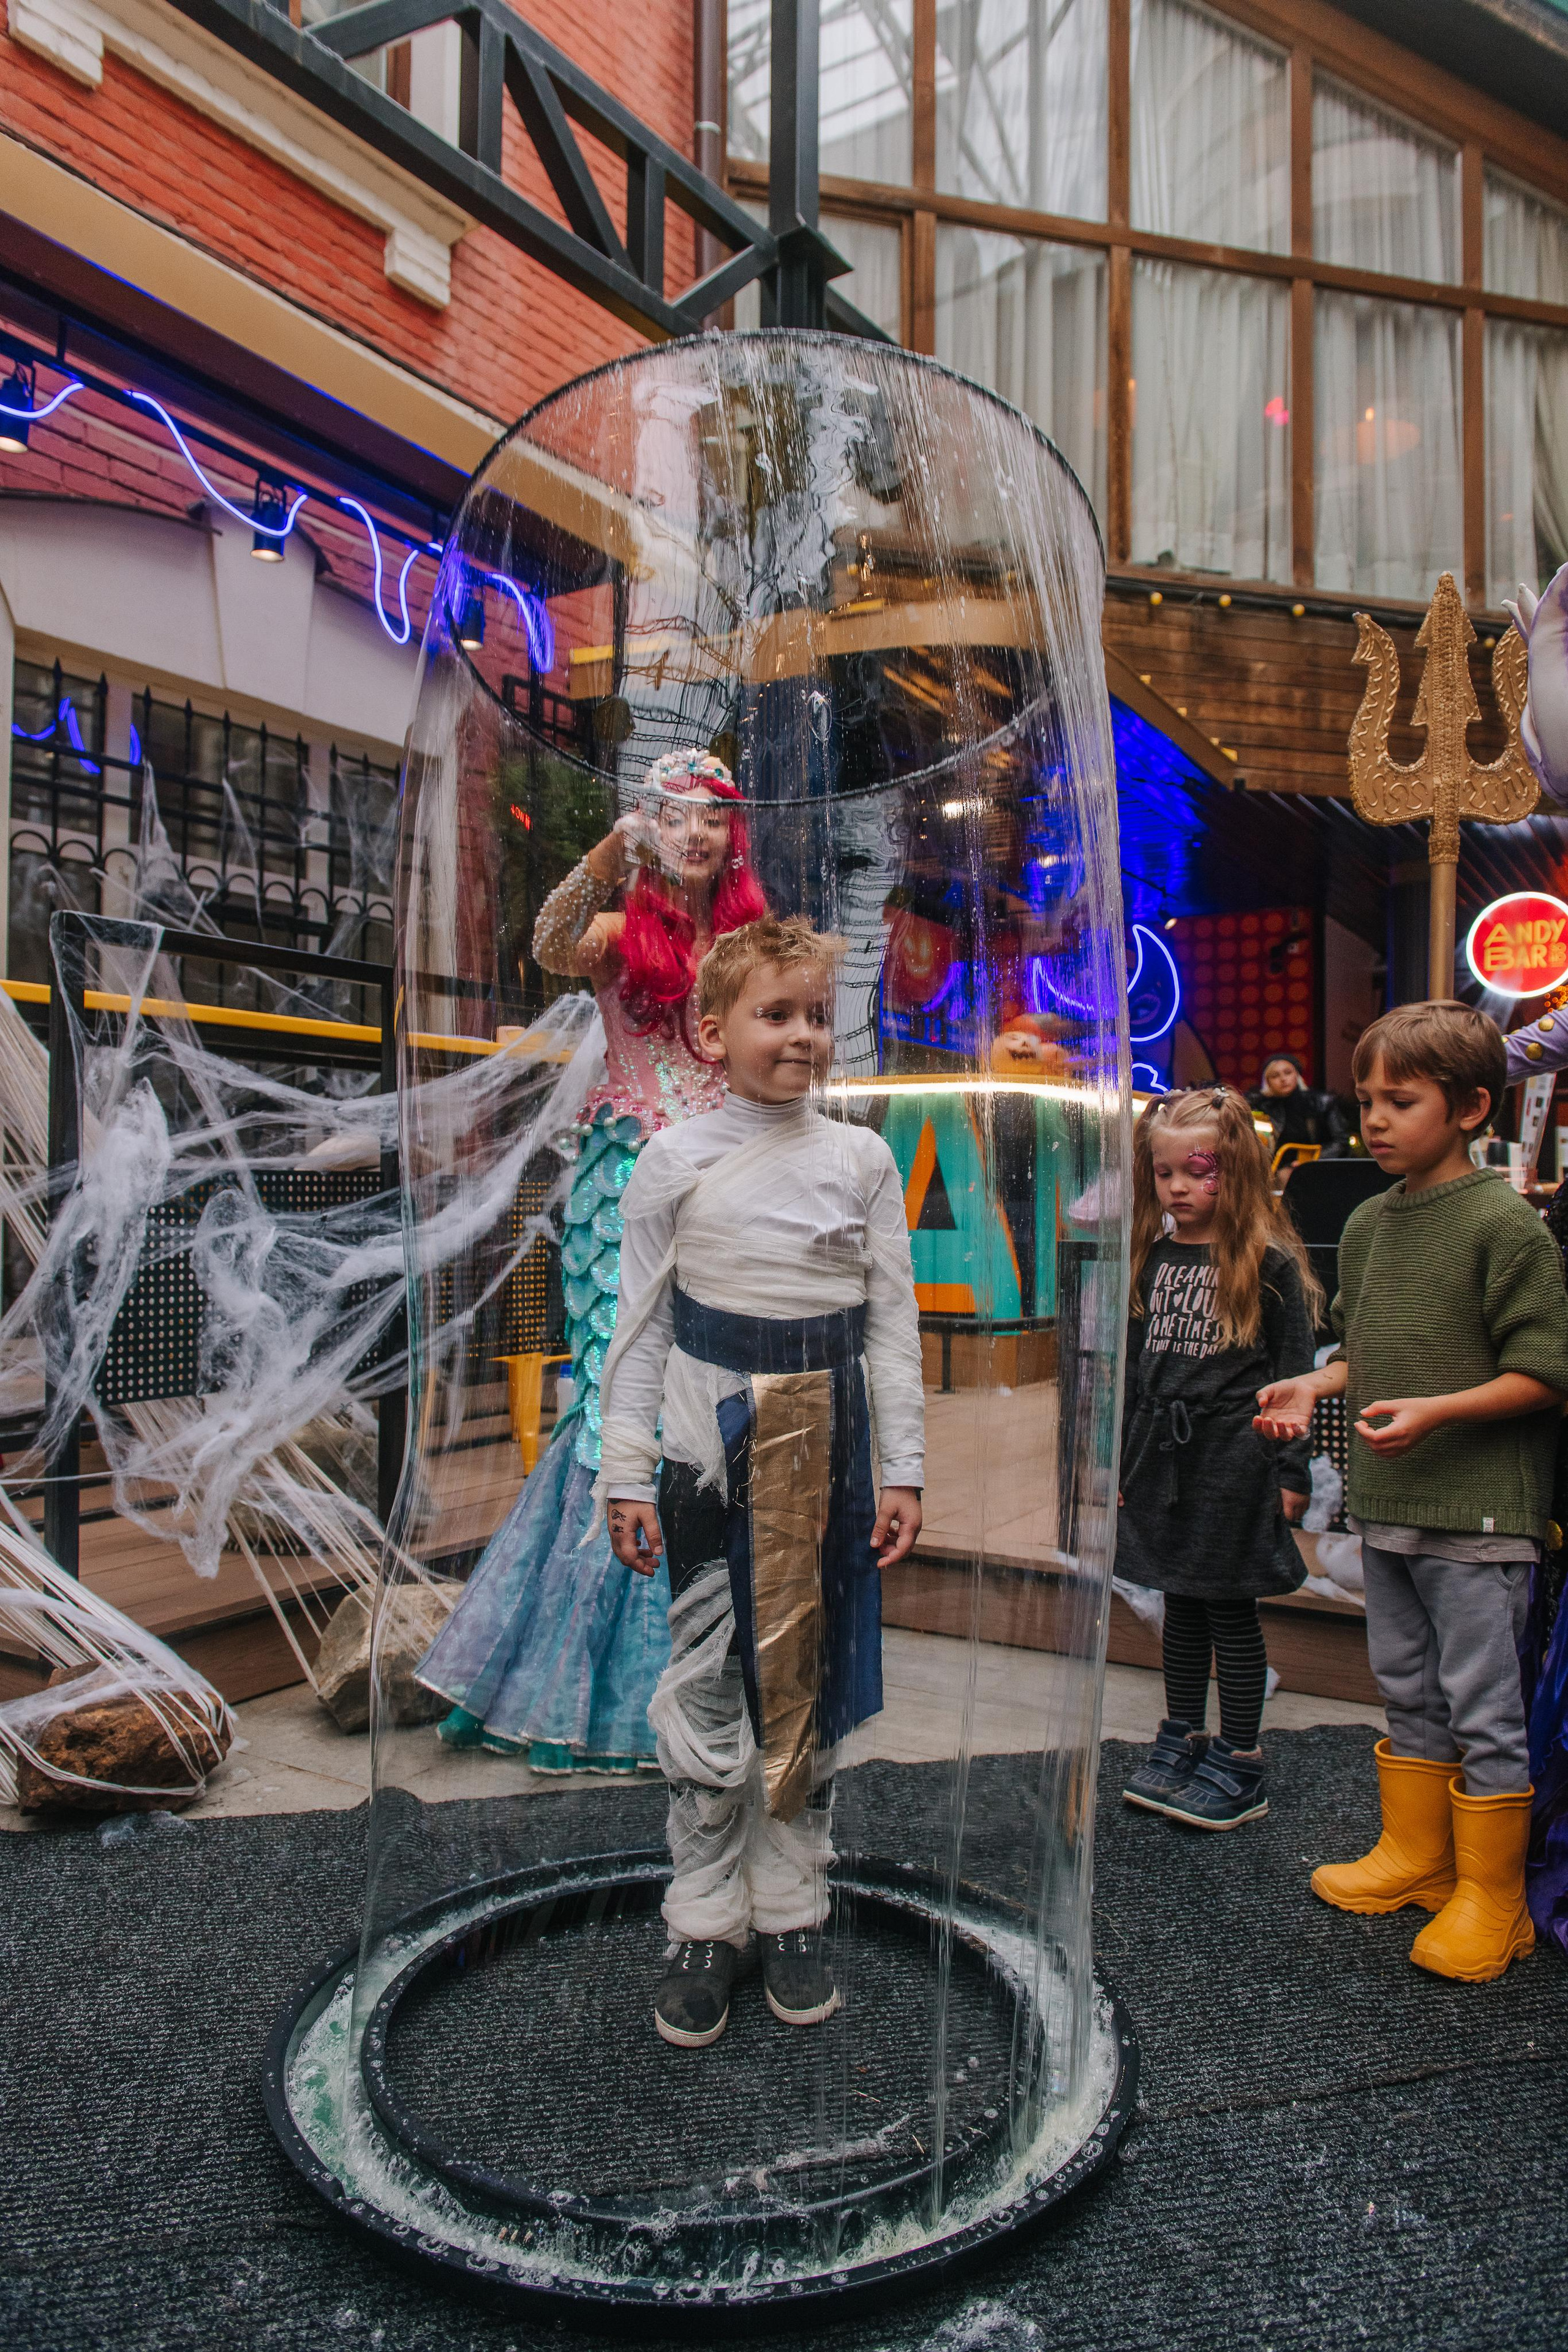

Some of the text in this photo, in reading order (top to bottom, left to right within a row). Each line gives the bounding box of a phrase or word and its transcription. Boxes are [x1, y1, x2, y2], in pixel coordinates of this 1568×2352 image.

[1482, 918, 1567, 948] ANDY
[1154, 1262, 1221, 1288] DREAMIN
[1150, 1286, 1175, 1313] OUT
[1145, 1313, 1220, 1349] SOMETIMES
[1172, 1341, 1182, 1353] IS
[1183, 1341, 1200, 1357] THE
[1199, 1343, 1219, 1360] DAY
